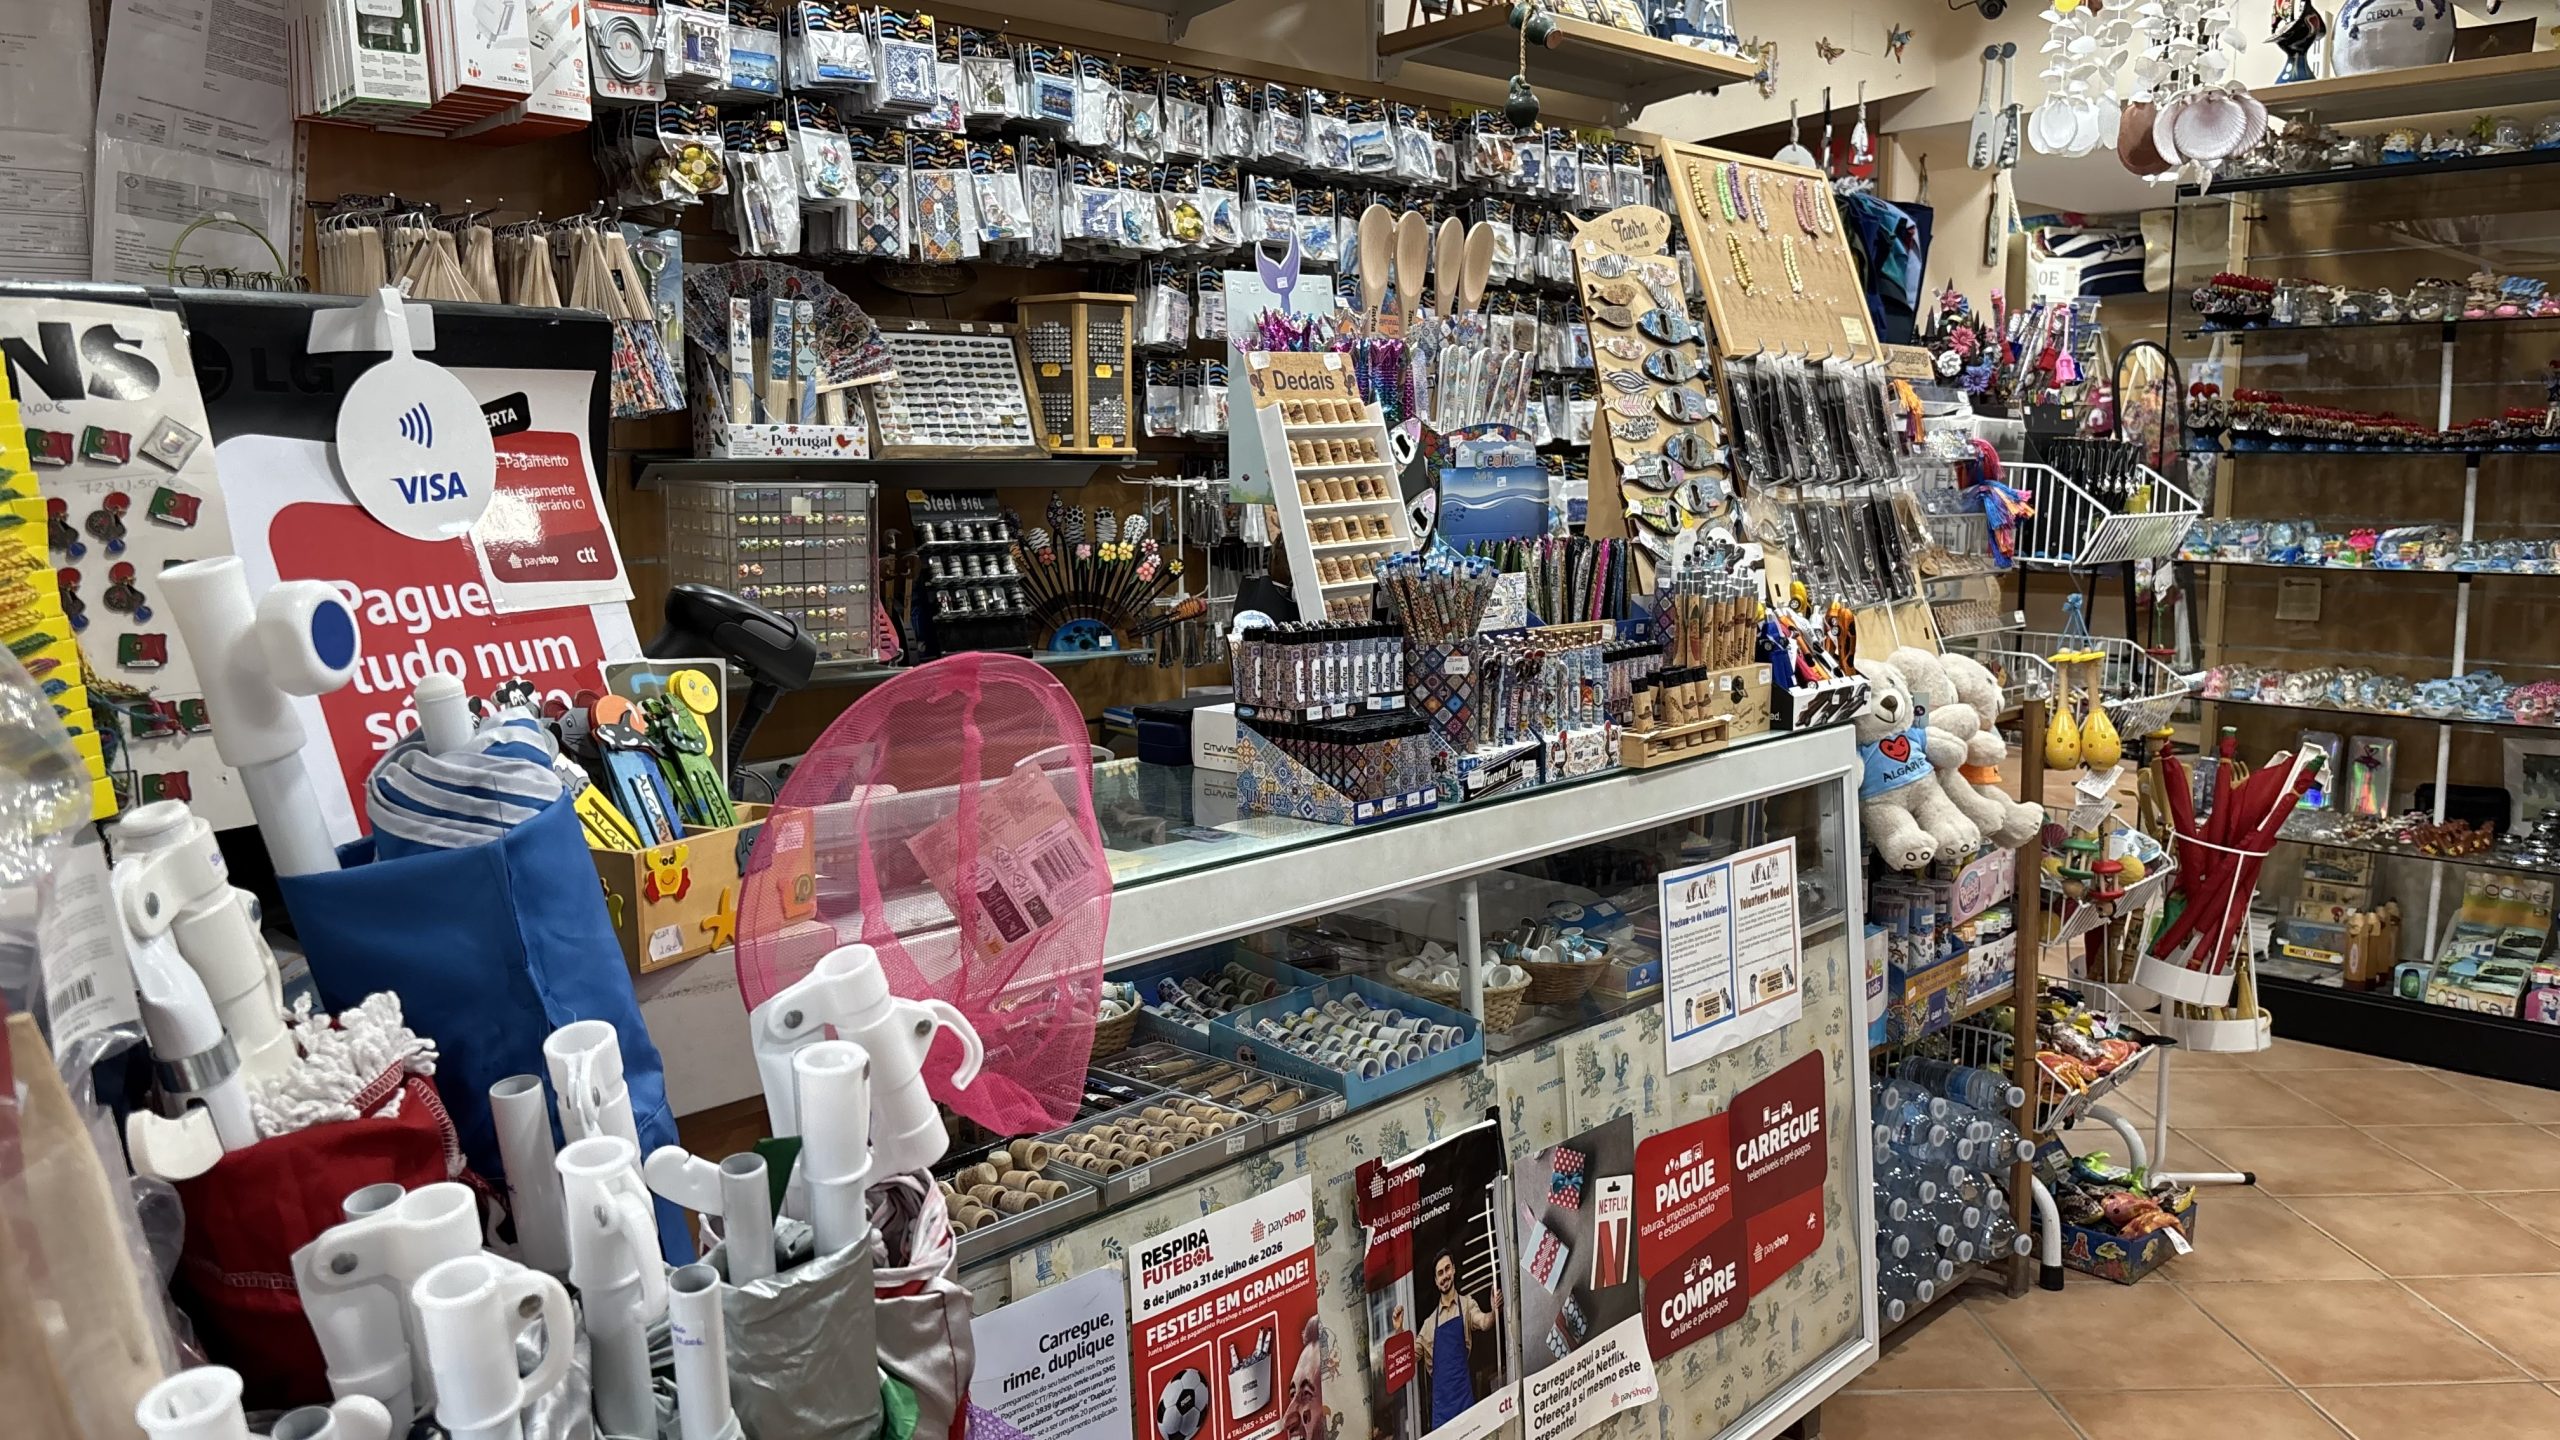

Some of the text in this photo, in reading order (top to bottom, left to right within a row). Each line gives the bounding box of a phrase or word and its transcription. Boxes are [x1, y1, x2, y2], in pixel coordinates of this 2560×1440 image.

[2366, 8, 2403, 21] CEBOLA
[619, 42, 632, 51] 1M
[1611, 216, 1650, 244] Tavira
[1272, 369, 1335, 390] Dedais
[771, 433, 833, 451] Portugal
[1475, 449, 1520, 469] Creative
[390, 470, 469, 506] VISA
[924, 493, 957, 512] Steel
[524, 548, 599, 568] payshop ctt
[352, 634, 582, 695] tudo num
[1382, 661, 1390, 689] Tavira
[1312, 669, 1321, 696] Tavira
[364, 692, 422, 752] só
[1510, 687, 1521, 728] PORTUGAL
[1482, 766, 1508, 787] Funny
[1246, 790, 1289, 807] UN 1057
[1740, 891, 1768, 911] Volunteers
[1770, 884, 1790, 900] Needed
[1735, 1106, 1820, 1171] CARREGUE
[1387, 1162, 1426, 1191] payshop
[1747, 1158, 1779, 1184] telemóveis
[1784, 1141, 1812, 1167] pré-pagos
[1655, 1158, 1716, 1213] PAGUE
[1267, 1207, 1307, 1236] payshop
[1372, 1184, 1454, 1230] Aqui, paga os impostos
[1598, 1194, 1629, 1216] NETFLIX
[1640, 1183, 1730, 1237] faturas, impostos, portagens
[1663, 1204, 1715, 1238] estacionamento
[1373, 1202, 1450, 1246] com quem já conhece
[1141, 1228, 1210, 1270] RESPIRA
[1763, 1232, 1789, 1258] payshop
[1142, 1245, 1214, 1290] FUTEBOL
[1143, 1241, 1283, 1311] 8 de junho a 31 de julho de 2026
[1146, 1257, 1309, 1347] FESTEJE EM GRANDE!
[1660, 1260, 1738, 1329] COMPRE
[1697, 1297, 1729, 1324] pré-pagos
[1039, 1312, 1114, 1354] Carregue,
[1180, 1334, 1187, 1343] de
[1187, 1321, 1216, 1342] pagamento
[1216, 1311, 1238, 1327] Payshop
[1242, 1302, 1258, 1315] troque
[1003, 1333, 1115, 1394] rime, duplique
[1395, 1352, 1411, 1366] 500€
[1533, 1340, 1617, 1397] Carregue aqui a sua
[998, 1388, 1039, 1411] carregamento
[1039, 1384, 1047, 1393] do
[1047, 1380, 1058, 1389] seu
[1058, 1368, 1085, 1384] telemóvel
[1085, 1363, 1096, 1372] nos
[1096, 1355, 1115, 1369] Pontos
[1001, 1363, 1116, 1421] Pagamento CTT/Payshop, envie uma SMS
[1533, 1350, 1628, 1414] carteira/conta Netflix.
[1534, 1361, 1641, 1430] Ofereça a si mesmo este
[1620, 1385, 1653, 1404] payshop
[1017, 1412, 1031, 1426] para
[1035, 1402, 1052, 1416] 3939
[1052, 1391, 1078, 1410] (gratuito)
[1078, 1386, 1091, 1396] com
[1091, 1380, 1104, 1391] uma
[1103, 1374, 1117, 1386] rima
[1049, 1423, 1059, 1432] ser
[1058, 1417, 1069, 1428] um
[1069, 1413, 1080, 1424] dos
[1080, 1408, 1088, 1419] 20
[1088, 1395, 1118, 1417] premiados
[1499, 1396, 1513, 1414] ctt
[1021, 1425, 1029, 1434] as
[1028, 1414, 1053, 1433] palavras
[1051, 1406, 1119, 1440] carregamento duplicado.
[1226, 1432, 1232, 1440] 4
[1231, 1420, 1255, 1437] TALÕES
[1534, 1411, 1577, 1440] presente!
